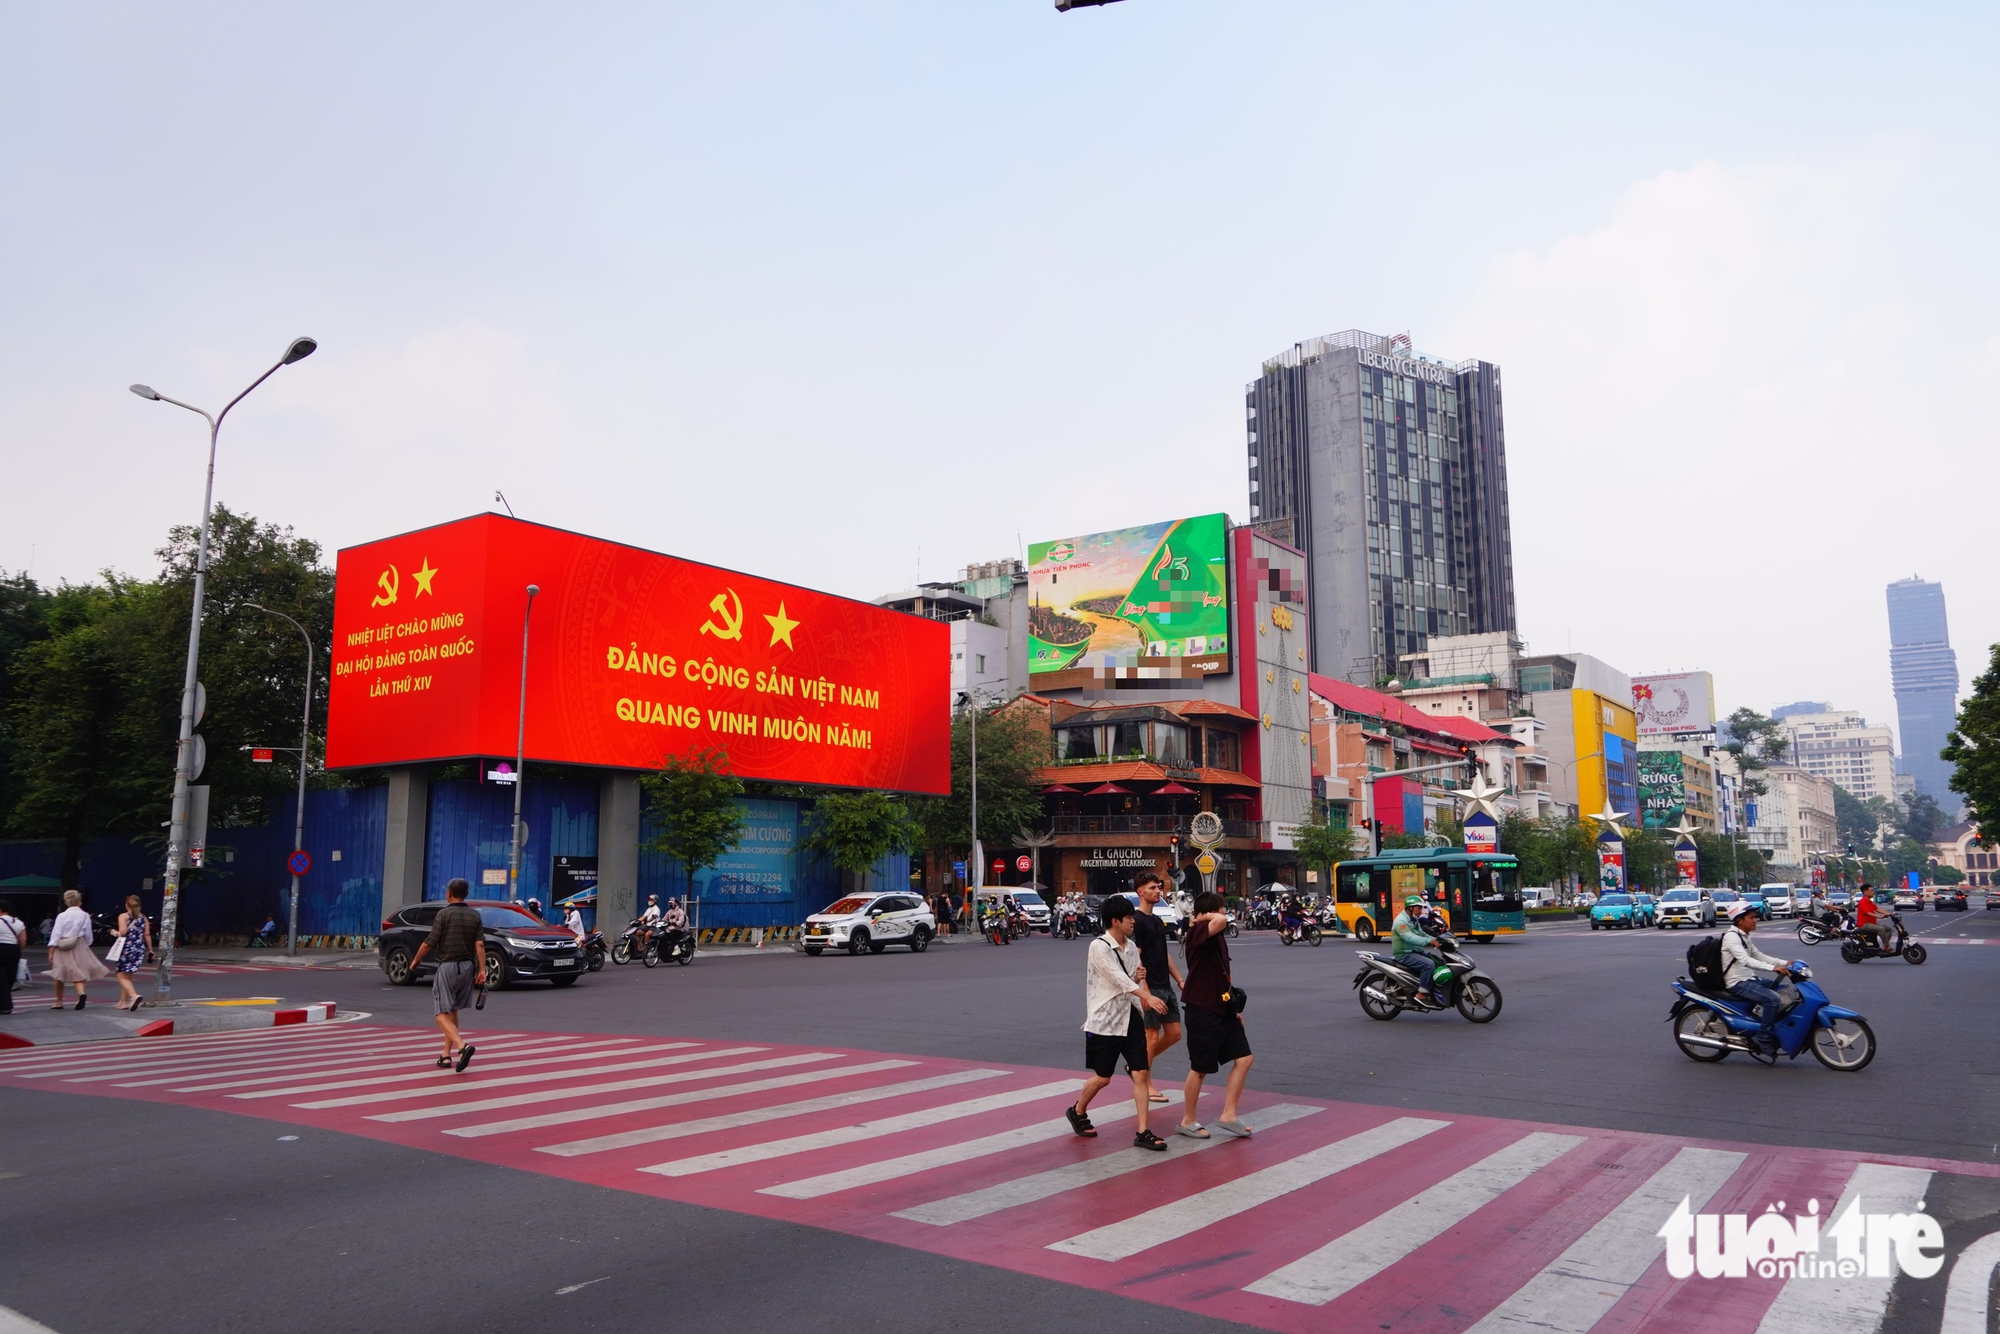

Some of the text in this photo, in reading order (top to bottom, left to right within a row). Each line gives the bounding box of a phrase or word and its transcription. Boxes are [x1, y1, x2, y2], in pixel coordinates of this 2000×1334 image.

[1358, 348, 1451, 386] LIBERTY CENTRAL
[1070, 561, 1091, 570] PHONG
[347, 612, 464, 647] NHIỆT LIỆT CHÀO MỪNG
[336, 635, 474, 678] ĐẠI HỘI ĐẢNG TOÀN QUỐC
[607, 641, 879, 710] ĐẢNG CỘNG SẢN VIỆT NAM
[370, 675, 432, 697] LẦN THỨ XIV
[615, 697, 872, 750] QUANG VINH MUÔN NĂM!
[1642, 772, 1677, 783] RỪNG
[1647, 796, 1675, 808] NHÀ
[758, 825, 791, 842] CƯƠNG
[1093, 848, 1143, 859] EL GAUCHO
[1080, 859, 1156, 867] ARGENTINIAN STEAKHOUSE
[739, 873, 744, 882] 3
[745, 873, 761, 882] 837
[762, 873, 782, 882] 2294
